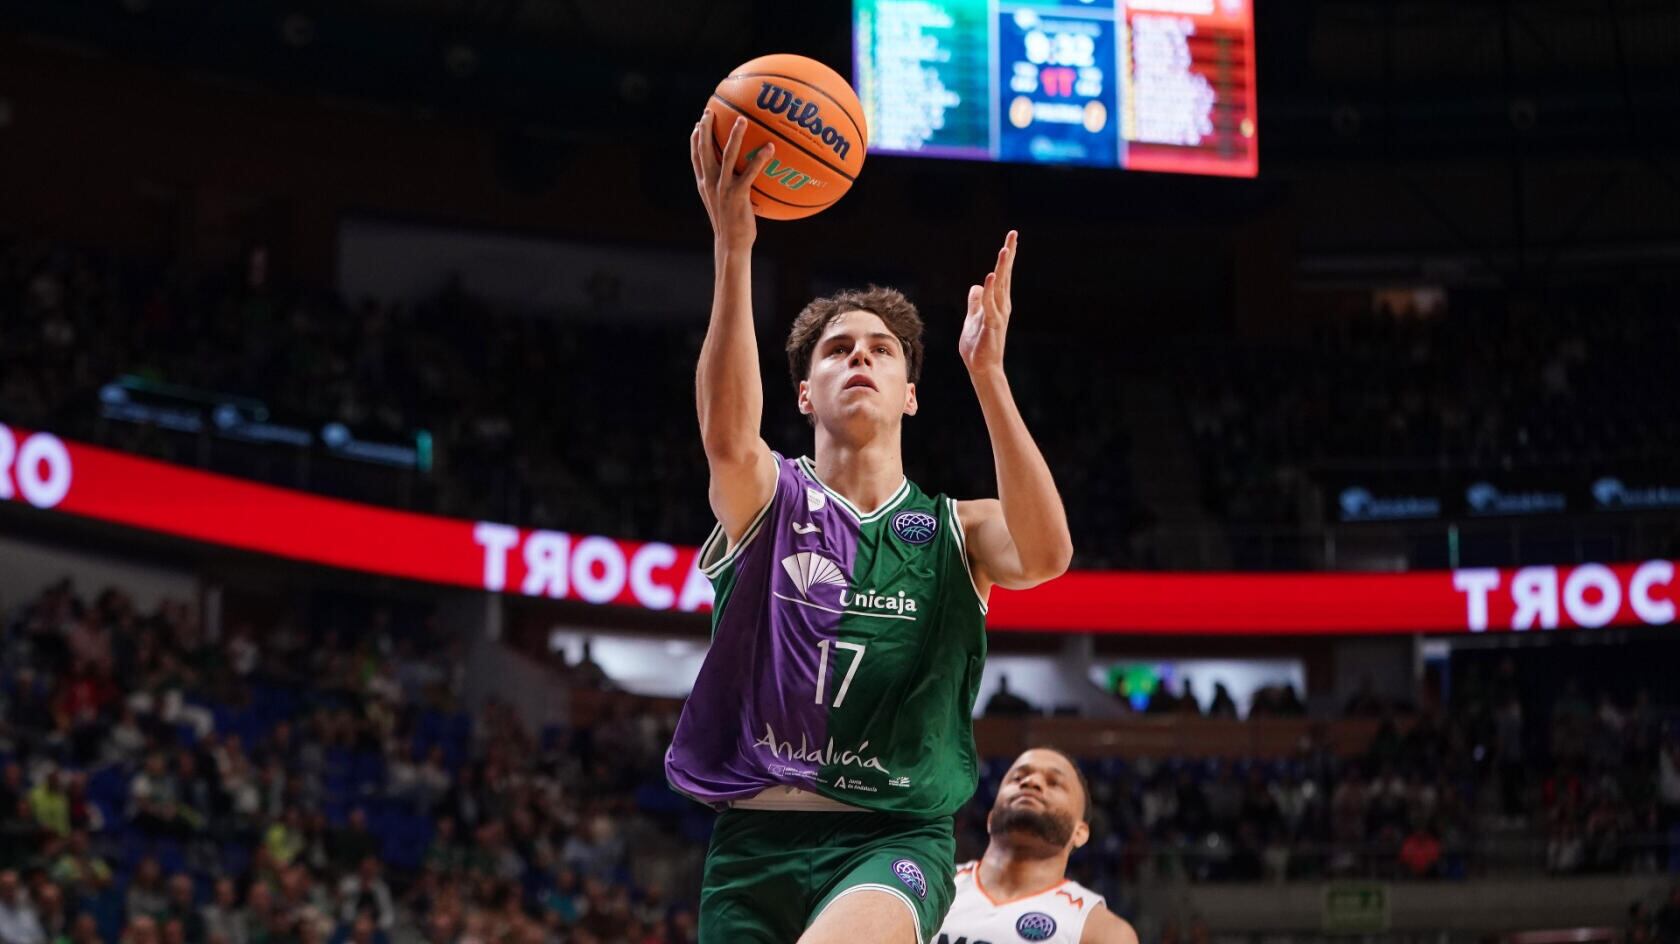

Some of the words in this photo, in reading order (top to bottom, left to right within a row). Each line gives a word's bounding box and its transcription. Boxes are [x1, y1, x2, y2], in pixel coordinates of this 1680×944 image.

[757, 81, 851, 161] Wilson
[745, 145, 812, 190] VO
[839, 589, 917, 613] Unicaja
[815, 639, 866, 708] 17
[753, 722, 890, 775] Andalucía
